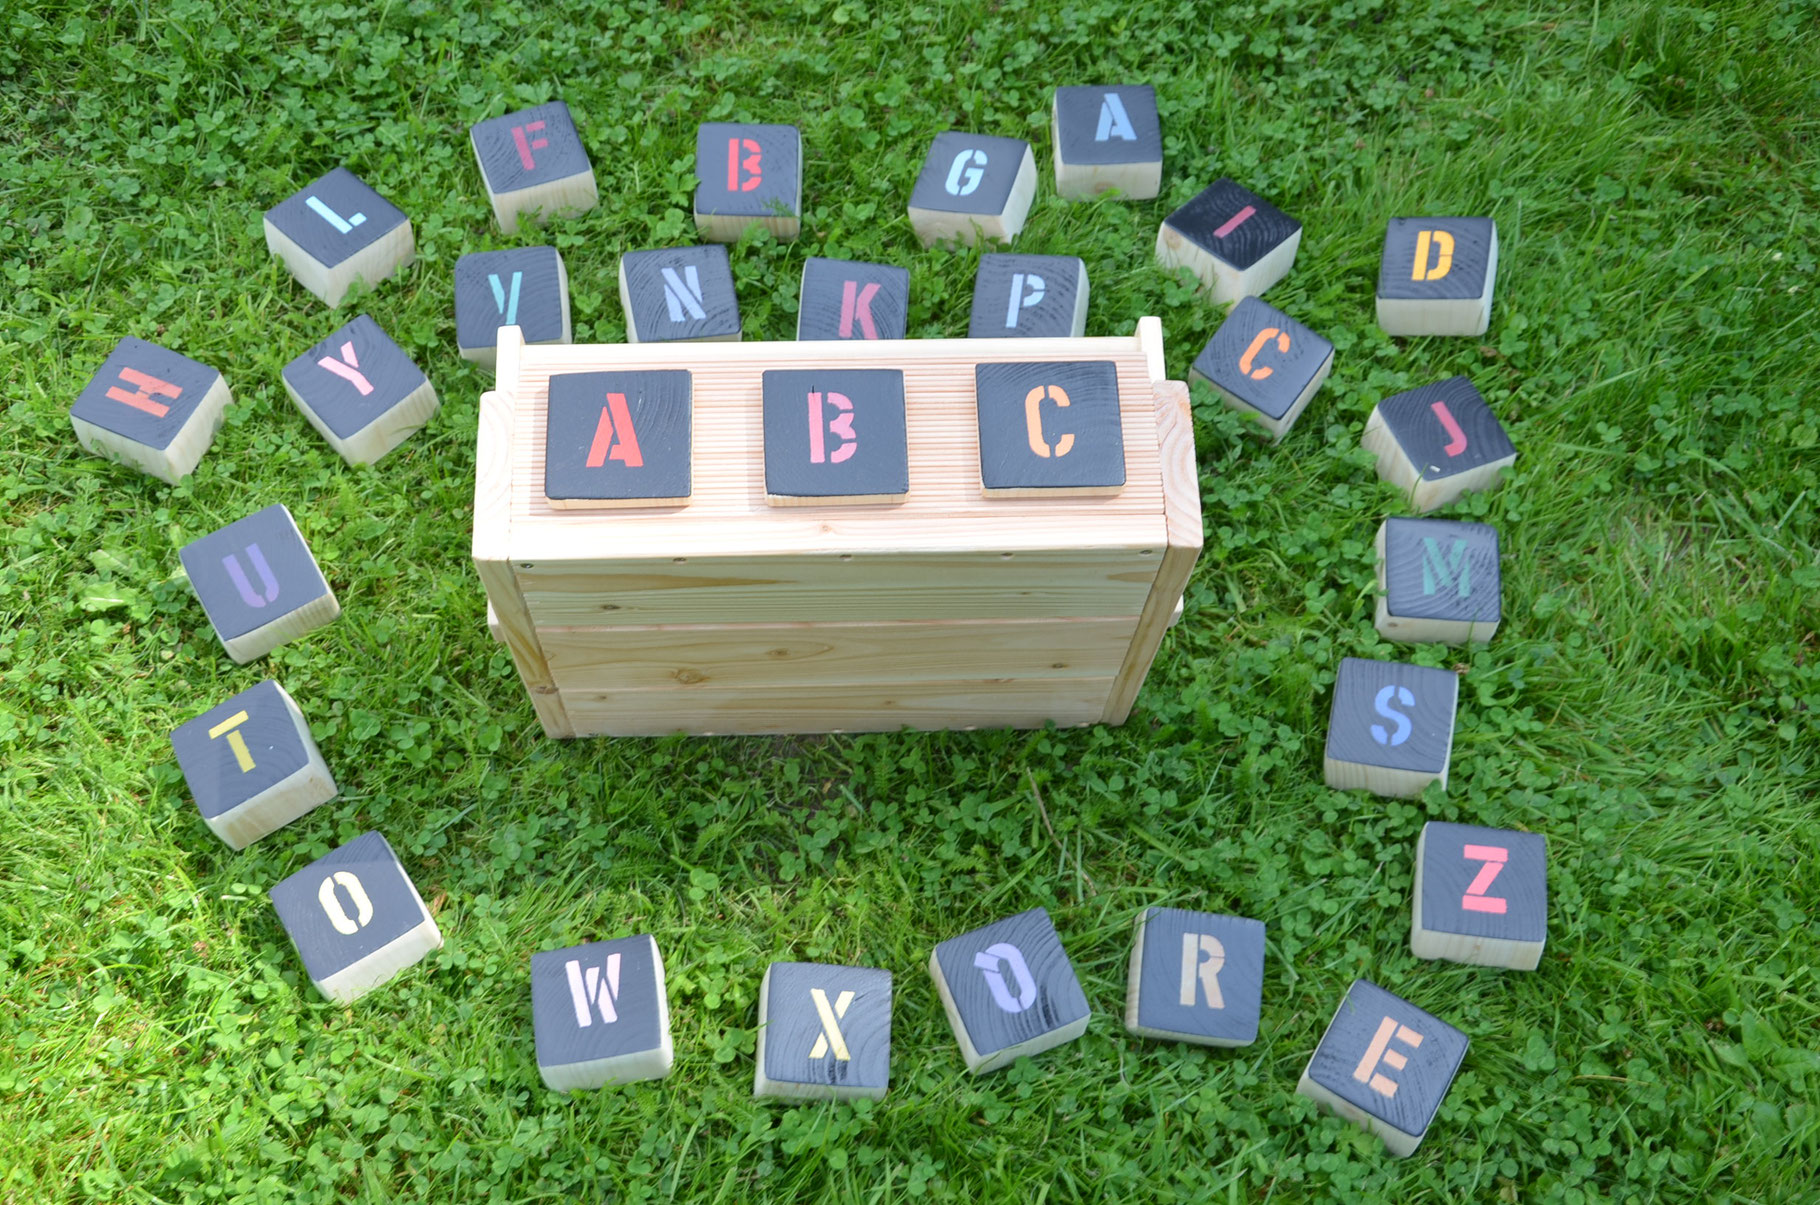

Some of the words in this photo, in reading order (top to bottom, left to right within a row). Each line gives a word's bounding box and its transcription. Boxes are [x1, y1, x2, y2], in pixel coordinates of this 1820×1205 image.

[511, 121, 548, 170] F
[1095, 93, 1137, 141] A
[728, 138, 762, 192] B
[945, 149, 988, 195] G
[305, 195, 367, 234] L
[1213, 205, 1256, 238] I
[1411, 230, 1455, 281] D
[488, 271, 523, 325] V
[661, 265, 707, 322] N
[838, 280, 882, 340] K
[1005, 273, 1045, 328] P
[317, 340, 374, 396] Y
[1239, 327, 1291, 381] C
[105, 366, 183, 417] H
[586, 393, 643, 467] A
[807, 391, 858, 464] B
[1024, 385, 1075, 458] C
[1430, 400, 1468, 457] J
[221, 543, 280, 608] U
[1422, 537, 1471, 597] M
[208, 709, 257, 774] T
[1370, 684, 1416, 747] S
[318, 871, 374, 935] O
[1461, 844, 1508, 914] Z
[564, 953, 621, 1028] W
[1179, 932, 1227, 1010] R
[809, 988, 855, 1061] X
[1353, 1015, 1423, 1098] E
